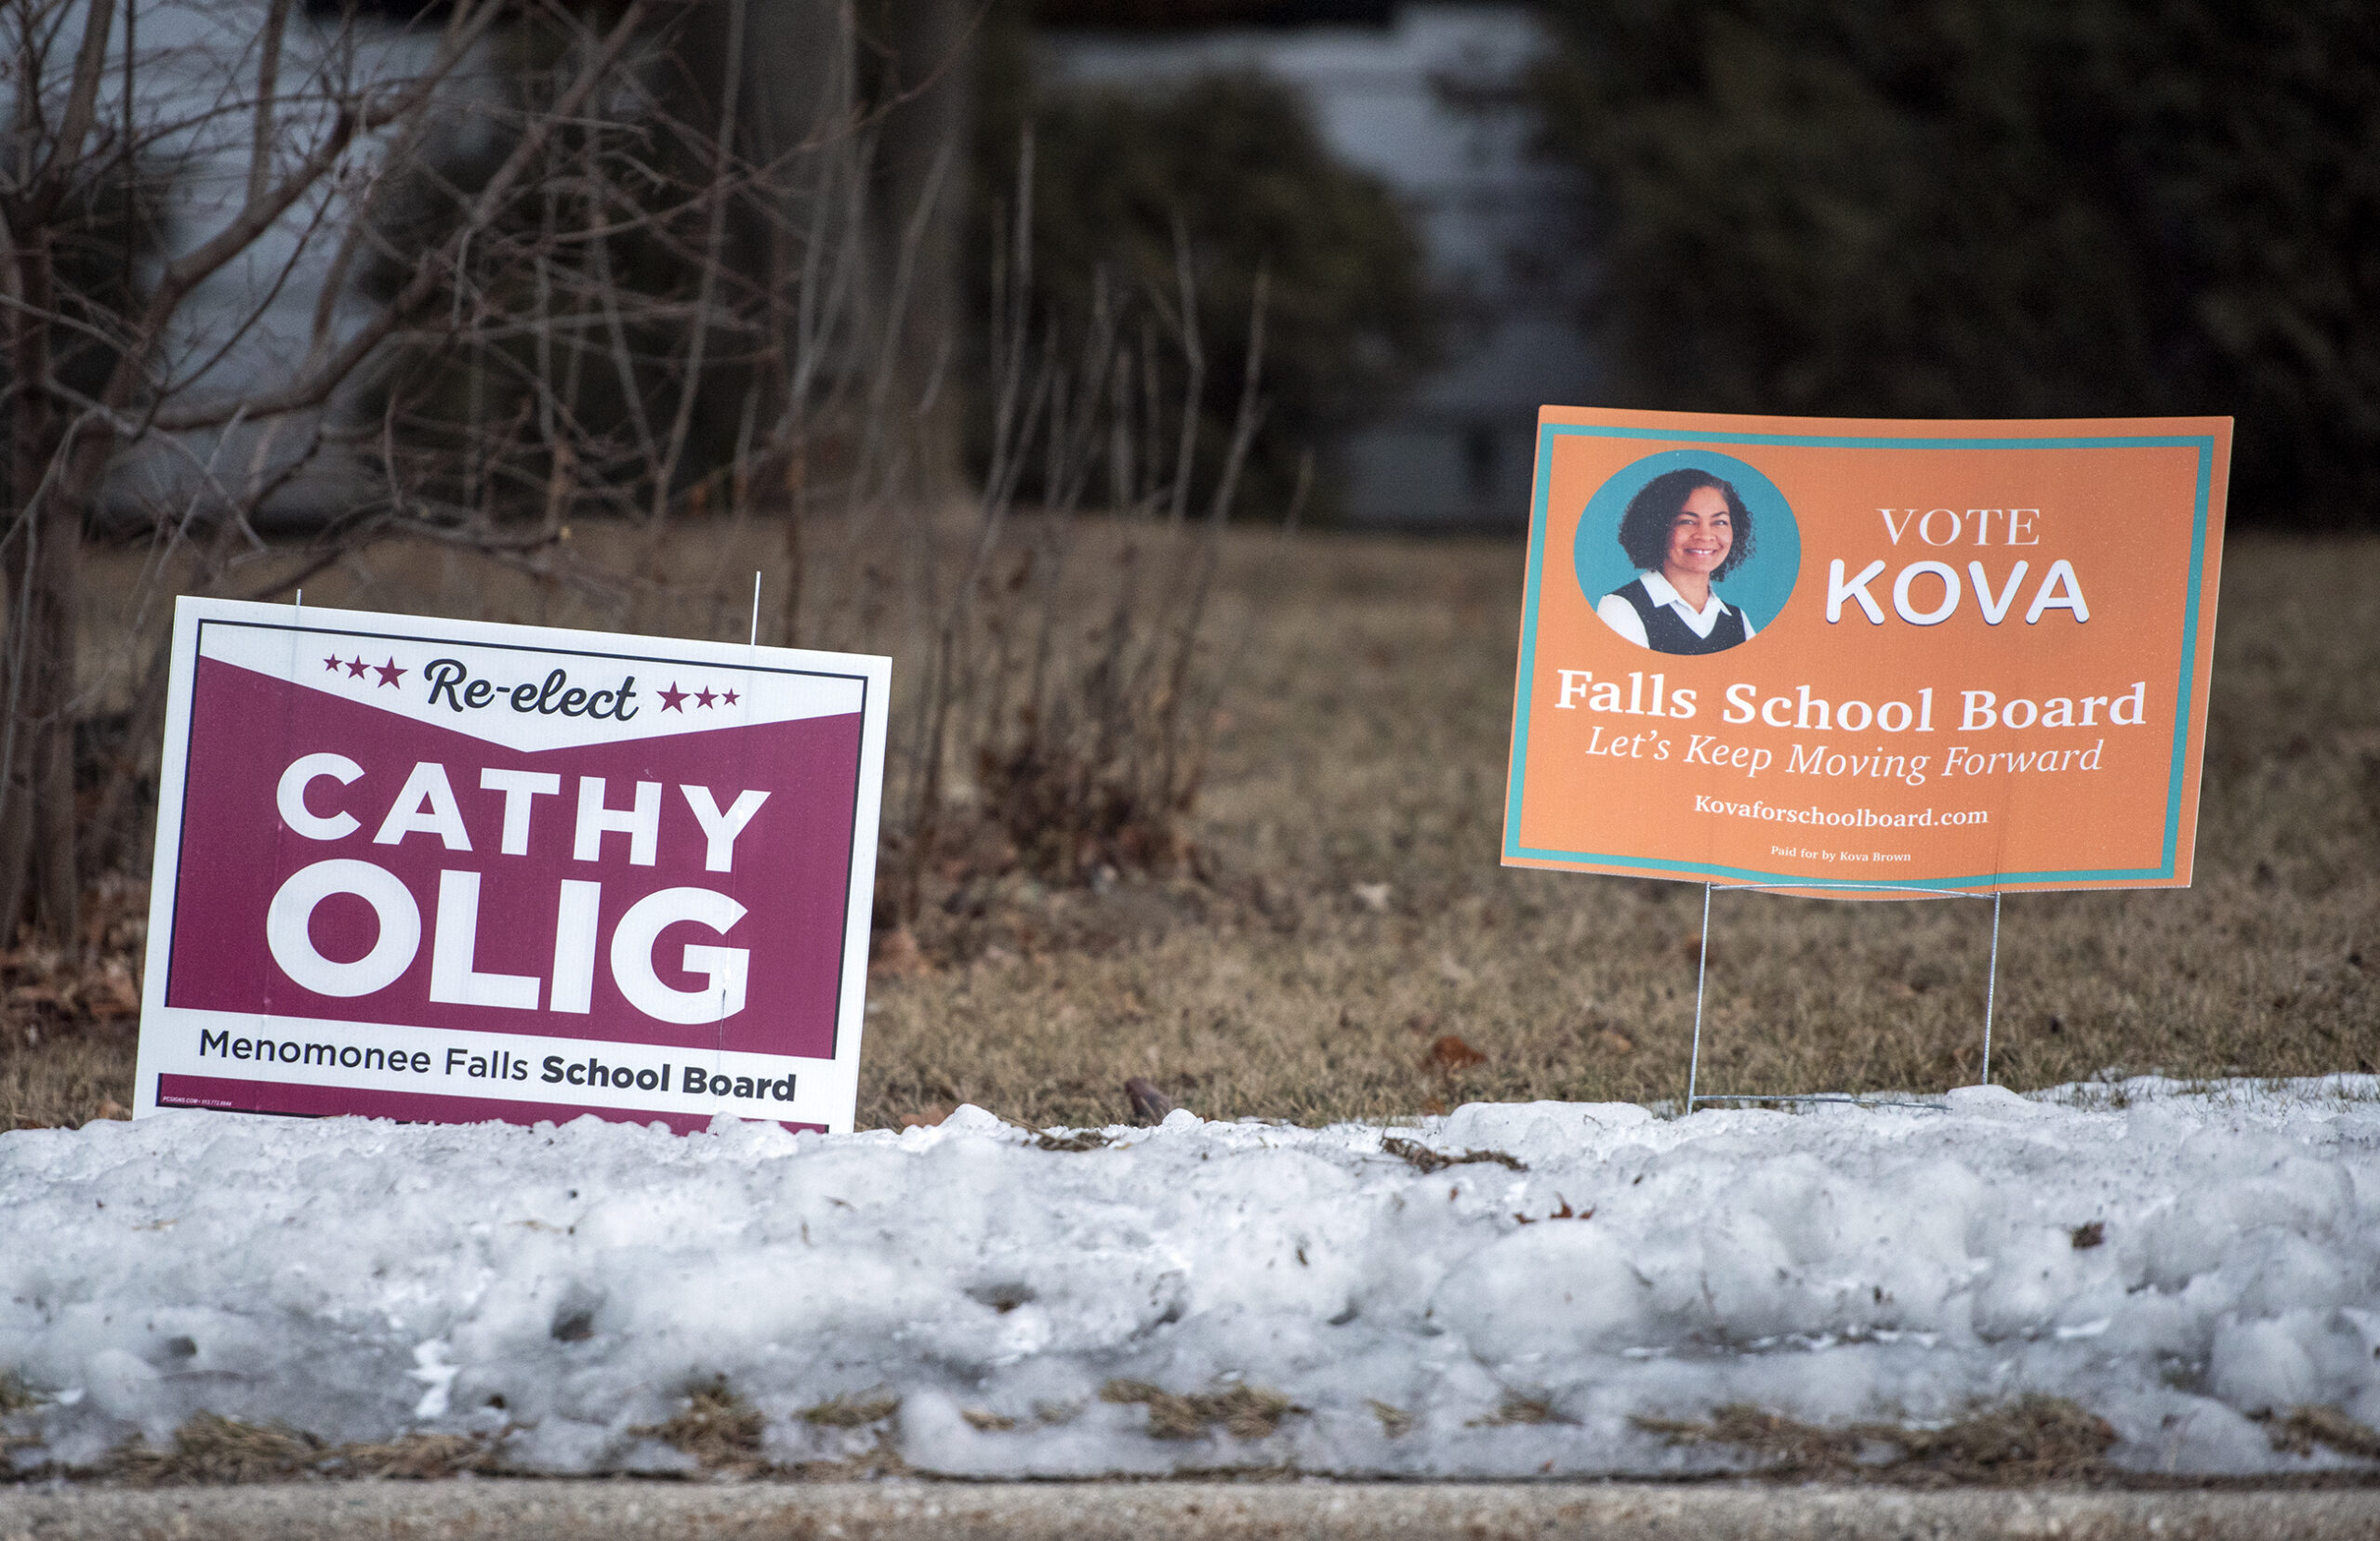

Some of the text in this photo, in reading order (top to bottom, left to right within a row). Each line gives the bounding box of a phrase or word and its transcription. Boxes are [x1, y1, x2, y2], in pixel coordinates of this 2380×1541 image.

[1876, 507, 2041, 547] VOTE
[1826, 559, 2091, 626] KOVA
[424, 659, 639, 721] Re-elect
[1554, 669, 2147, 731] Falls School Board
[1585, 726, 2104, 785] Let’s Keep Moving Forward
[276, 752, 772, 873] CATHY
[1694, 795, 1989, 827] Kovaforschoolboard.com
[1770, 846, 1911, 863] Paid for by Kova Brown
[266, 859, 750, 1025] OLIG
[199, 1029, 797, 1102] Menomonee Falls School Board
